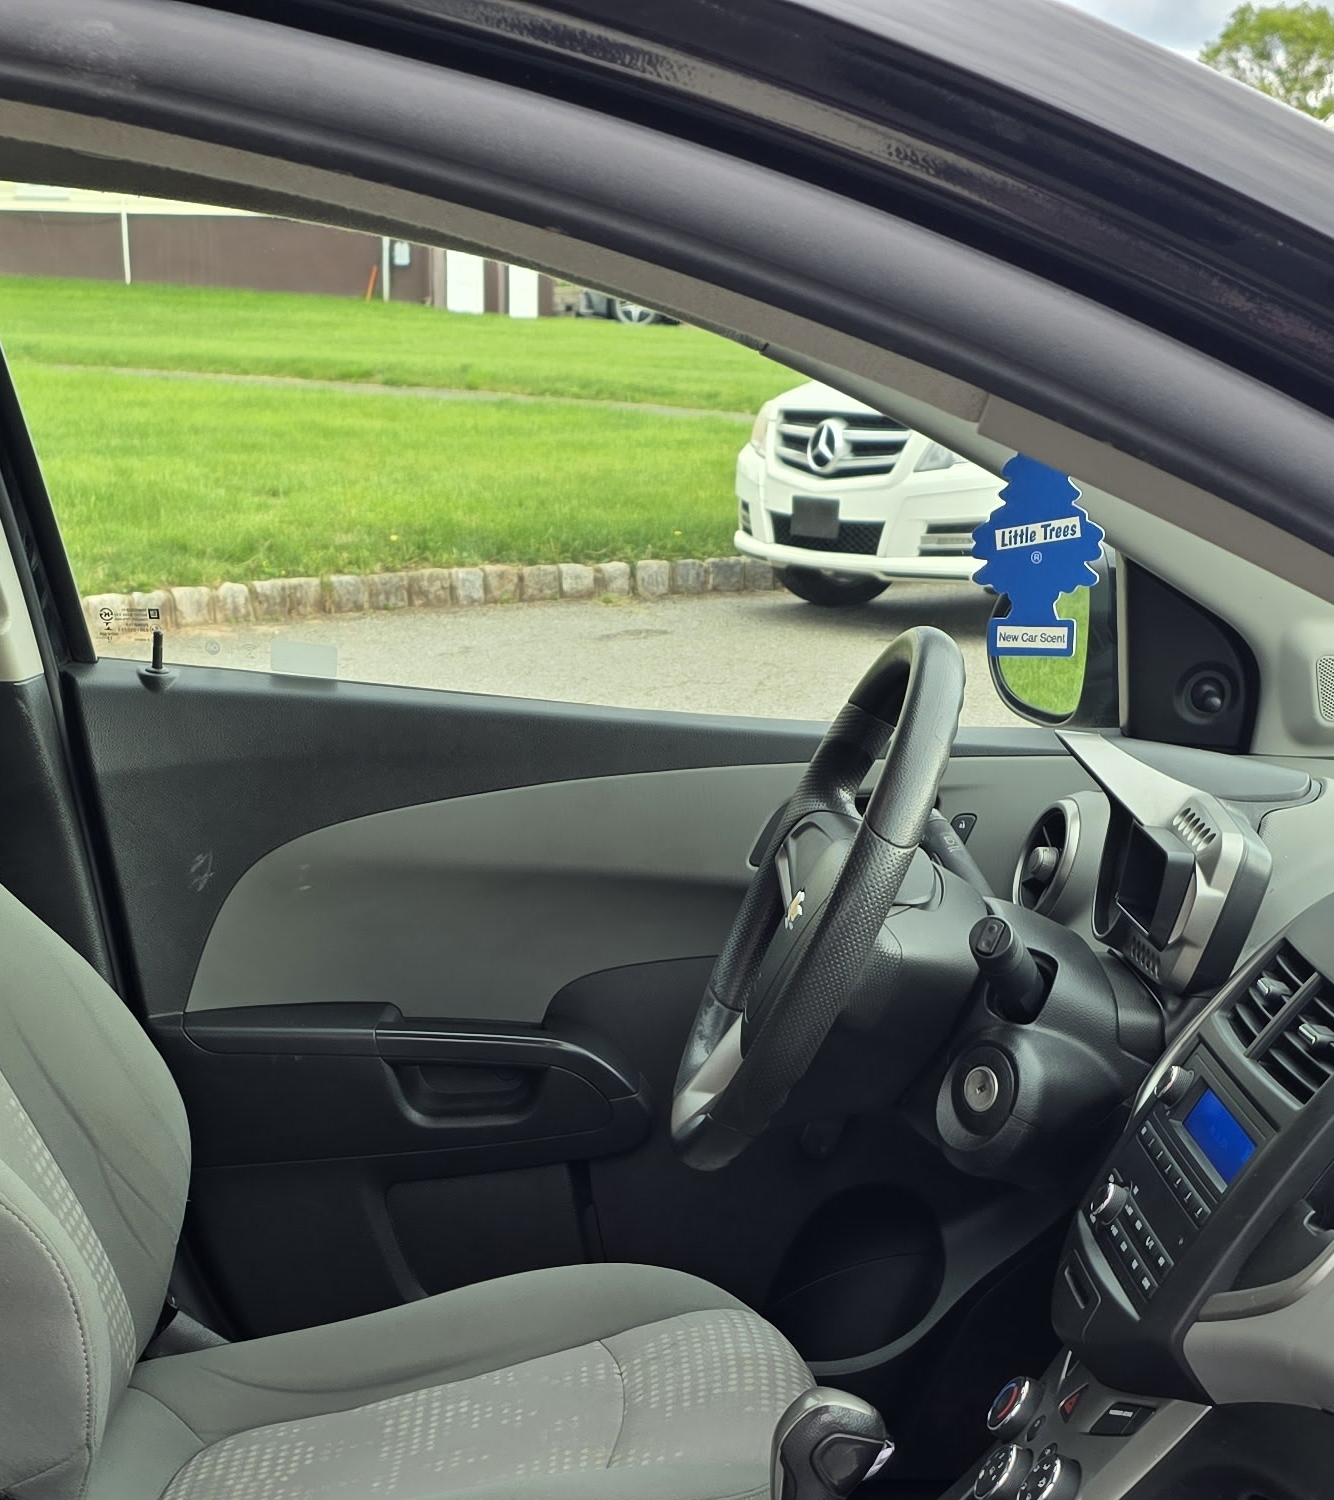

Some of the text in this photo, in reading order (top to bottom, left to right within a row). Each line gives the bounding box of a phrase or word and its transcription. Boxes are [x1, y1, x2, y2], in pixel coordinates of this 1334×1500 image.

[1000, 521, 1078, 549] Little Trees
[998, 632, 1066, 645] New Car Scent
